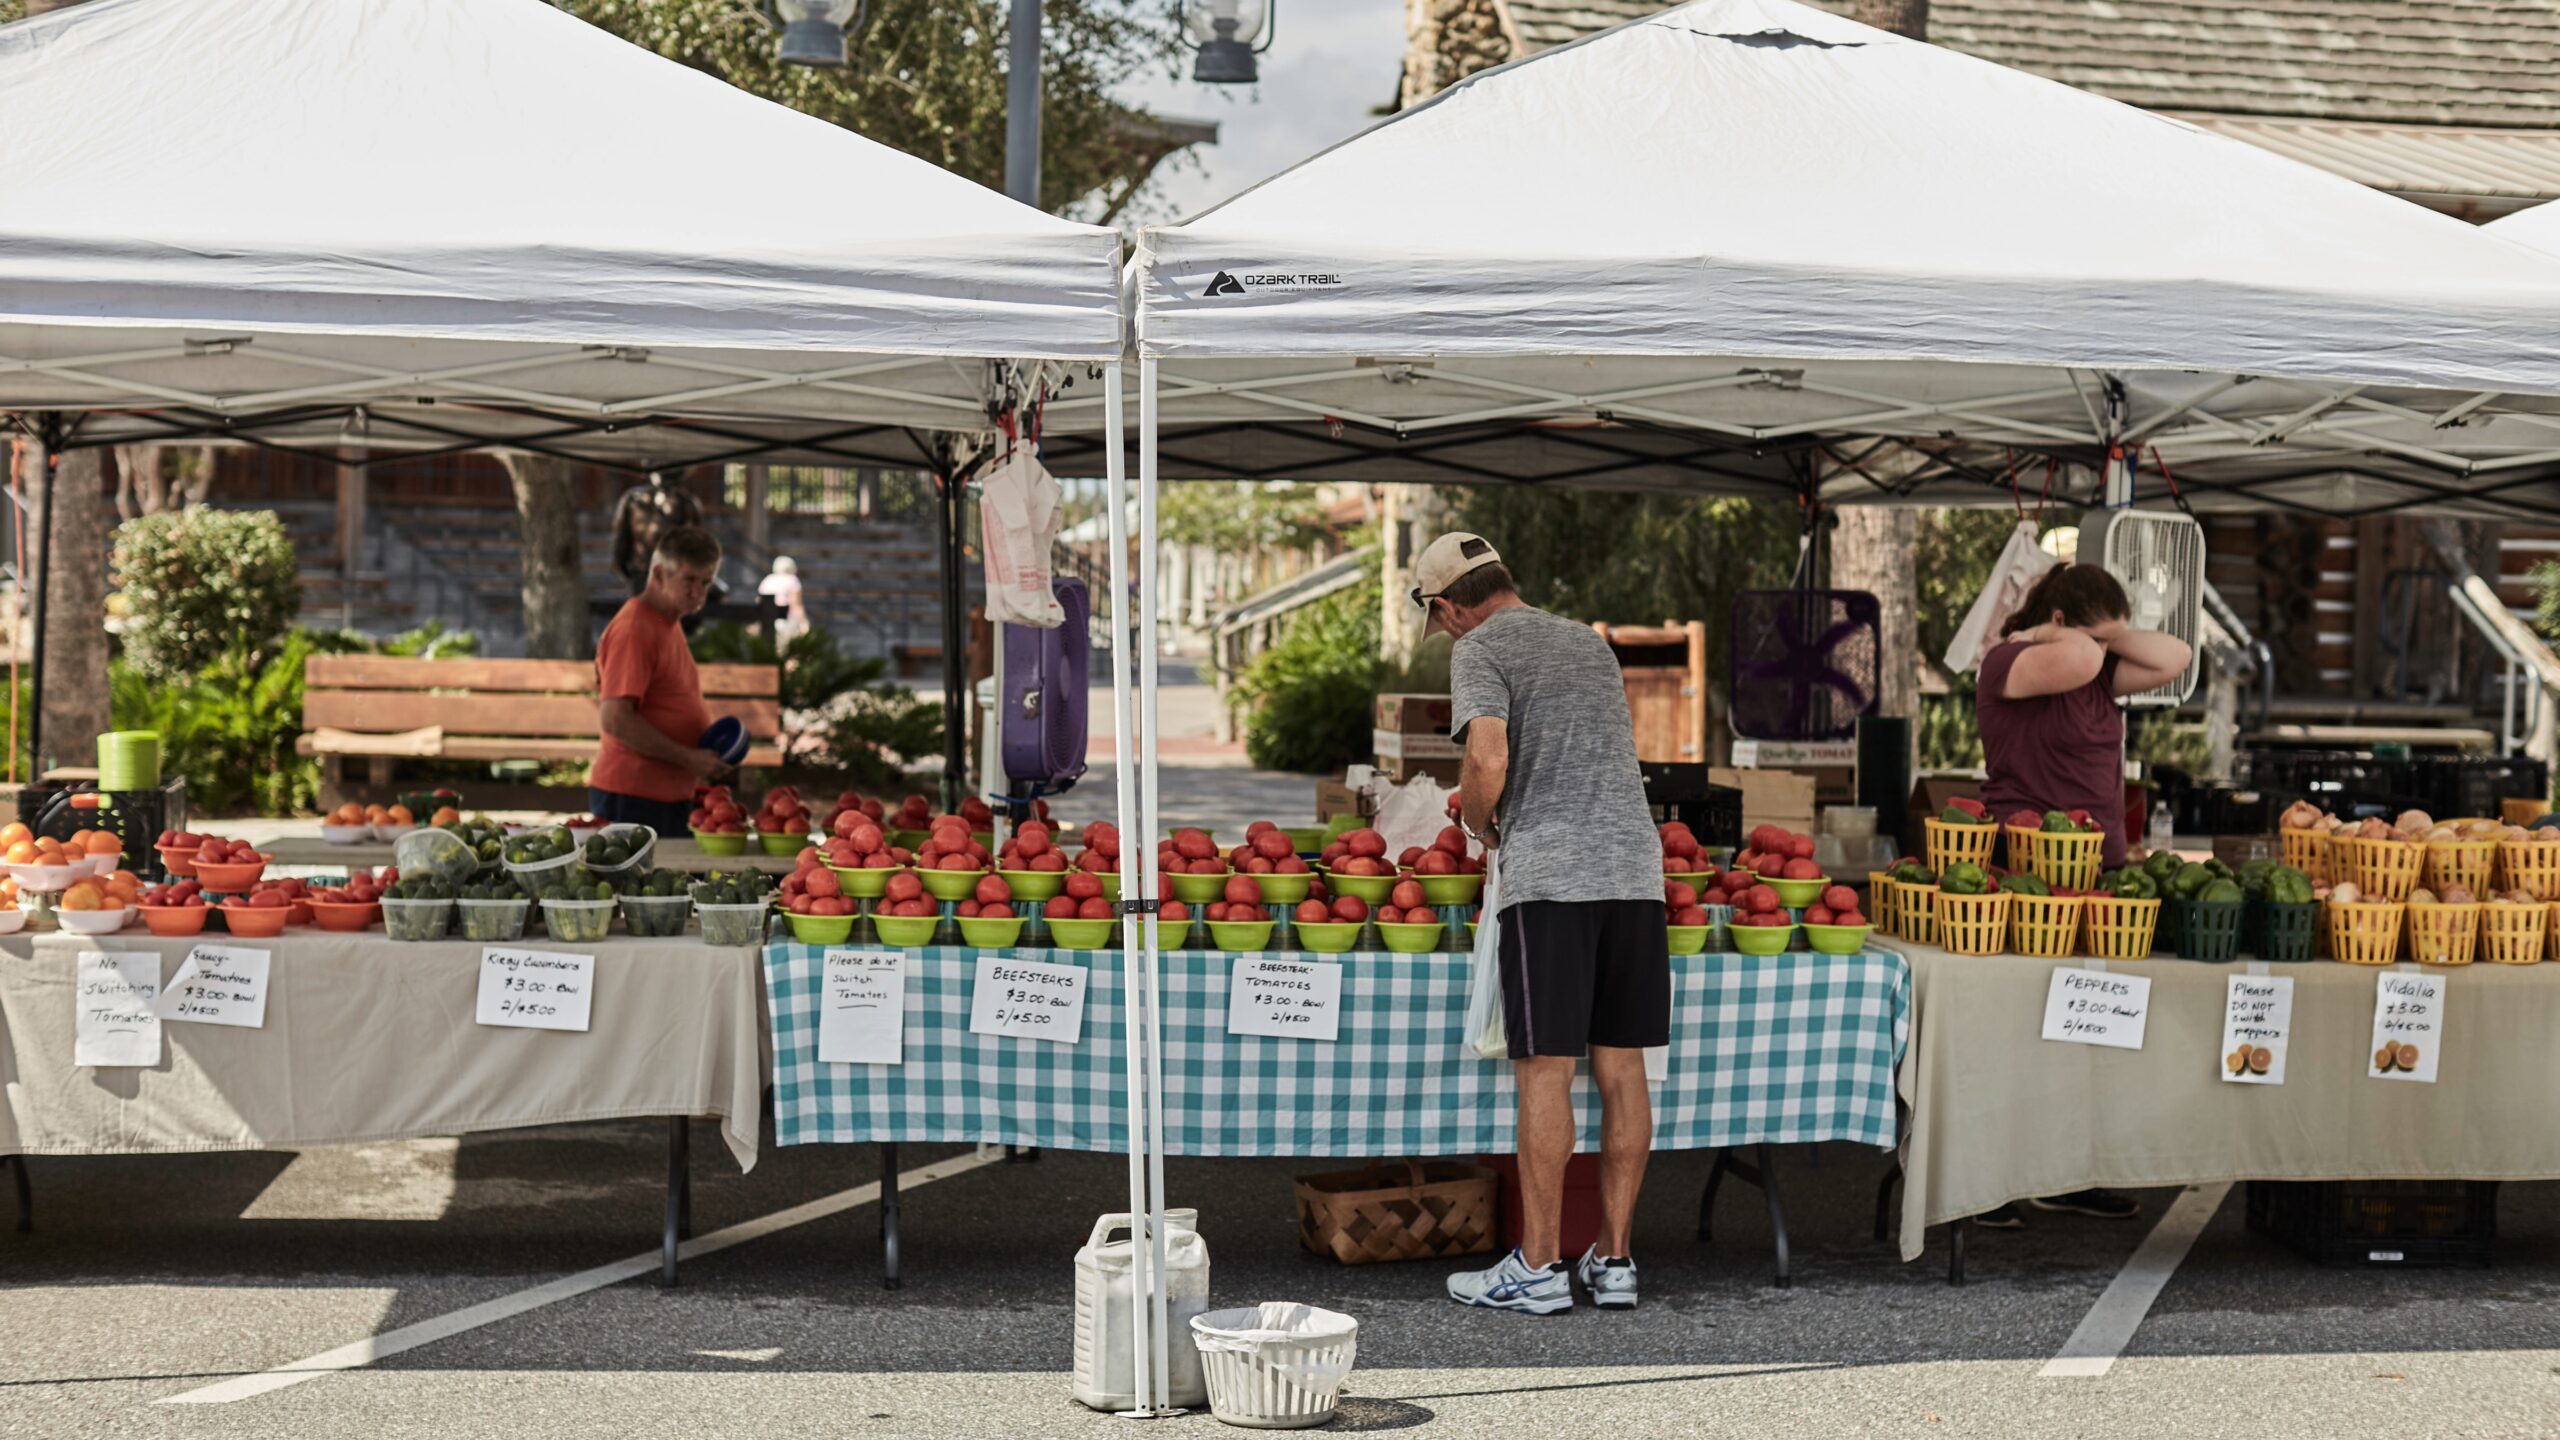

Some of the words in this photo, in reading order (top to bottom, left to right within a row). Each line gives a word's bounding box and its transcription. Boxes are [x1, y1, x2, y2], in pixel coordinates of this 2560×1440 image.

[1245, 274, 1296, 285] OZARK
[1298, 274, 1342, 285] TRAIL
[1810, 748, 1854, 760] TOMAT
[99, 956, 119, 970] No
[829, 954, 863, 966] Please
[870, 956, 881, 965] do
[992, 966, 1074, 987] BEEFSTEAKS
[84, 982, 154, 999] Switching
[1245, 977, 1312, 991] TOMATOES
[2065, 973, 2130, 996] PEPPERS
[2234, 982, 2275, 996] Please
[2384, 978, 2436, 999] Vidalia
[835, 988, 888, 999] Tomatoes
[2231, 1001, 2248, 1011] DO
[2251, 1002, 2276, 1012] NOT
[89, 1008, 154, 1024] Tomatoes
[2234, 1027, 2281, 1040] peppers
